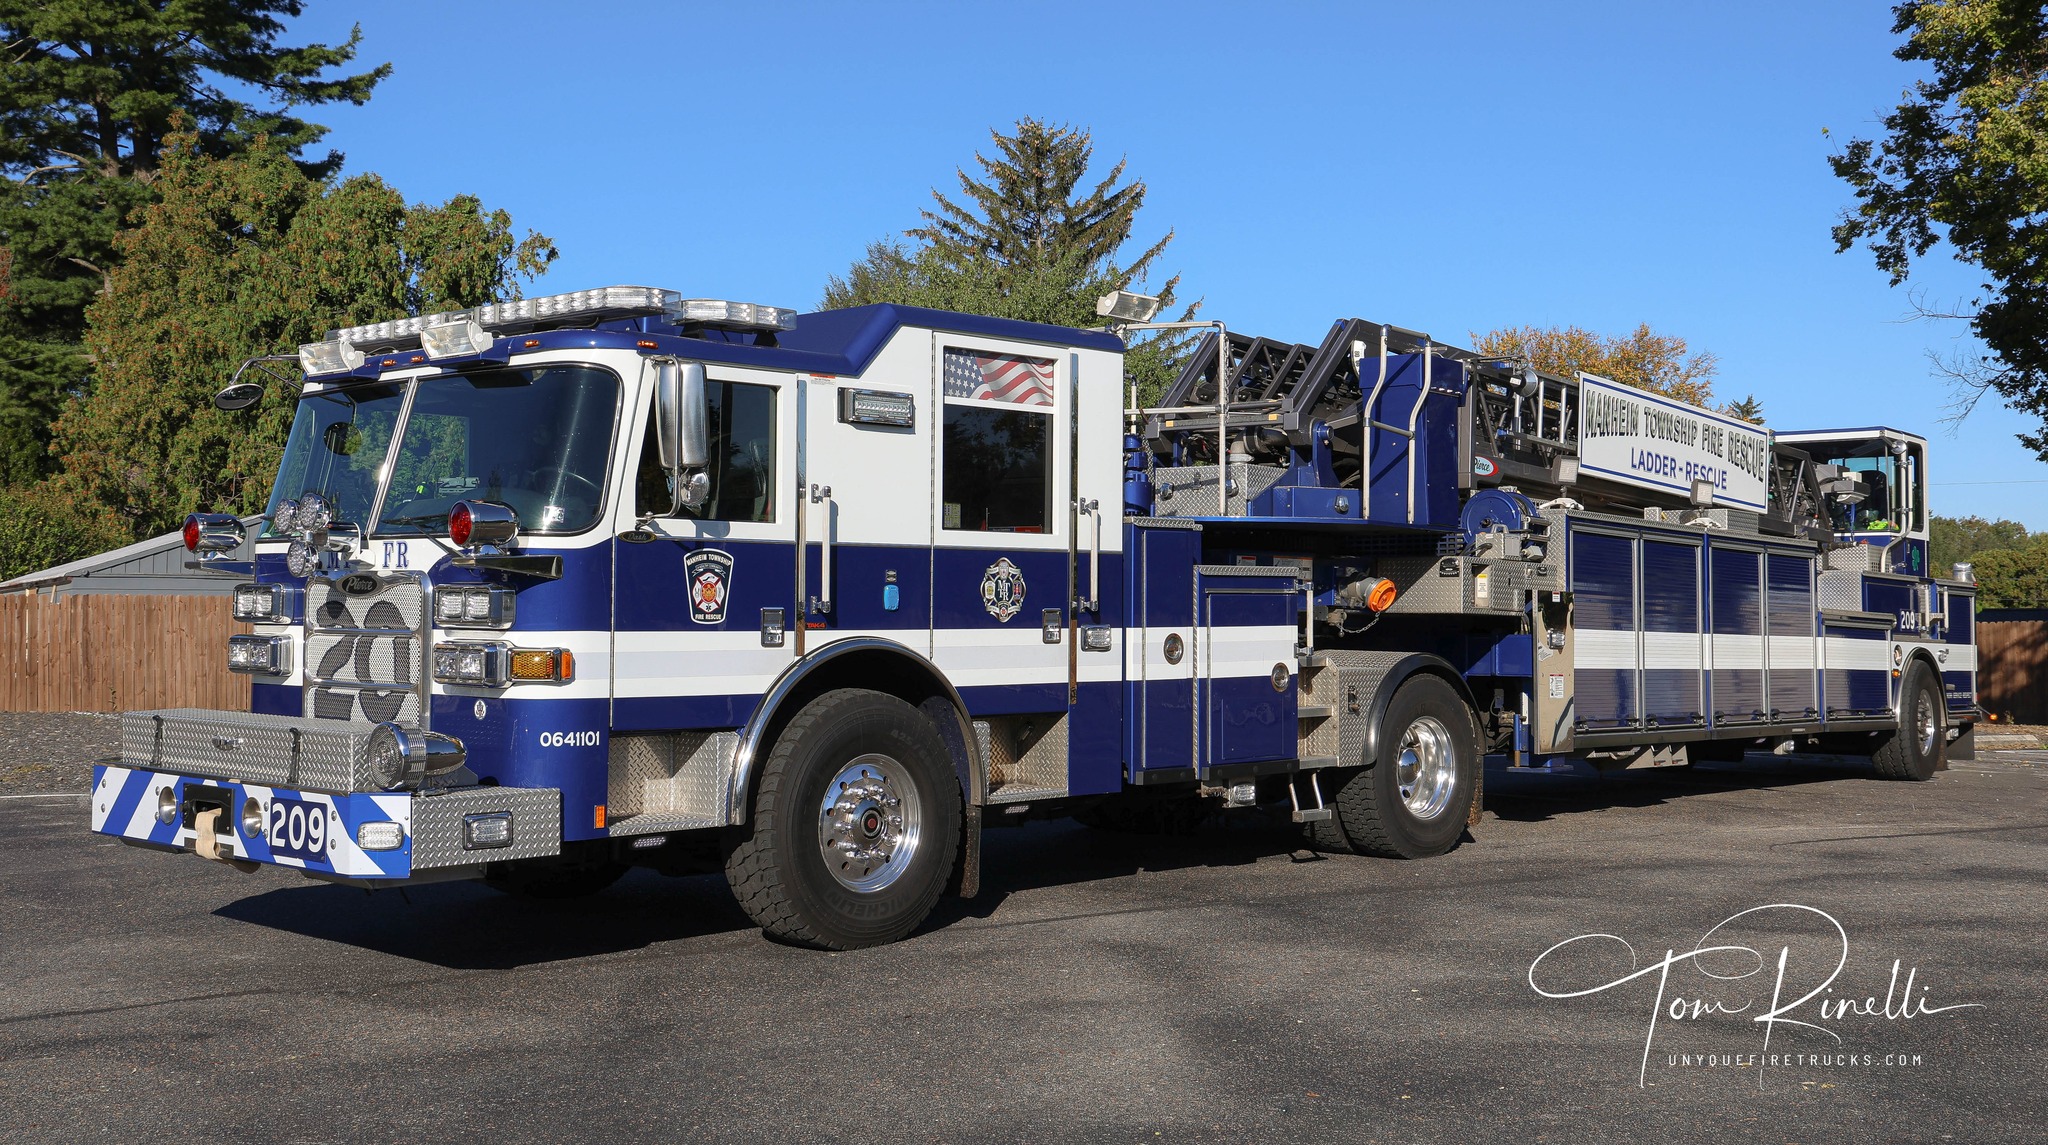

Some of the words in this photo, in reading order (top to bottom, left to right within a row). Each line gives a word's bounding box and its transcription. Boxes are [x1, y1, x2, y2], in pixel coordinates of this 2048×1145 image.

[1585, 389, 1639, 438] MANHEIM
[1644, 406, 1697, 447] TOWNSHIP
[1702, 423, 1723, 458] FIRE
[1727, 430, 1764, 483] RESCUE
[383, 541, 409, 568] FR
[687, 554, 707, 566] MANHEIM
[708, 554, 731, 566] TOWNSHIP
[345, 576, 373, 592] Pierce
[1901, 611, 1915, 629] 209
[540, 731, 600, 747] 0641101
[271, 802, 325, 853] 209
